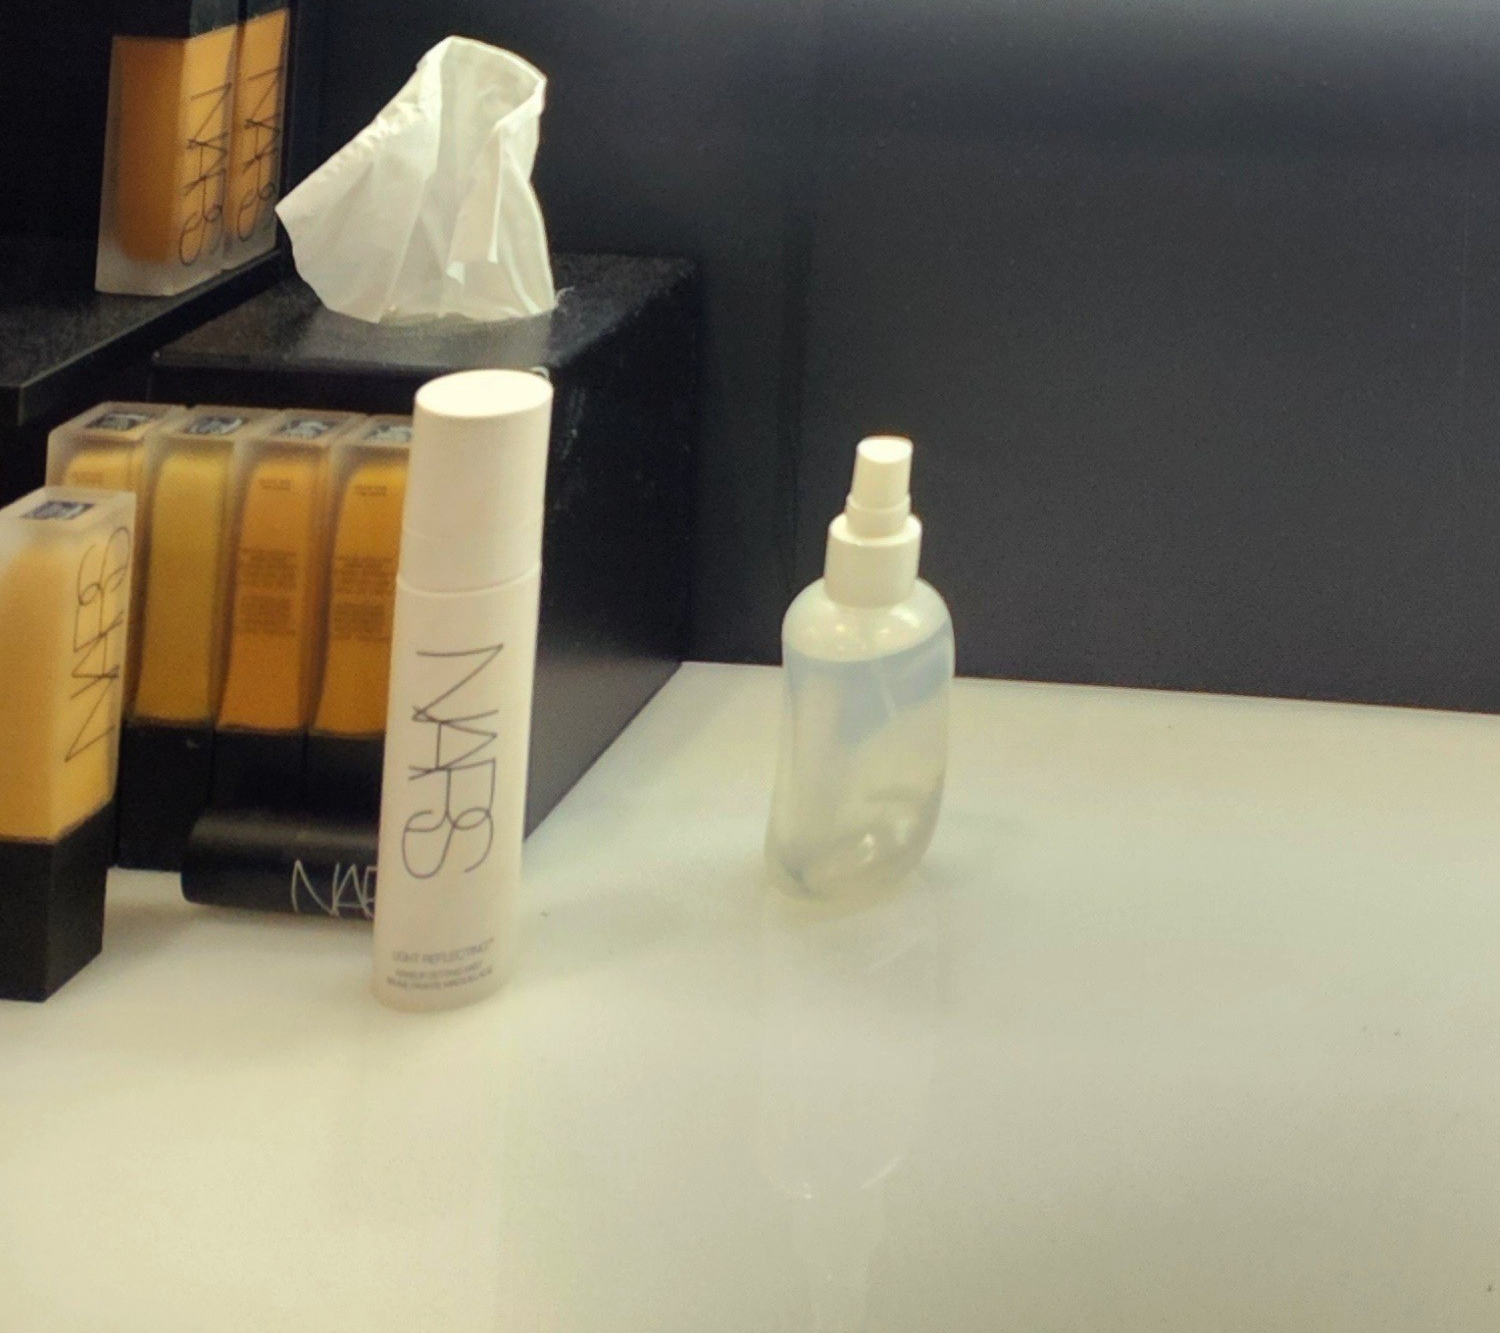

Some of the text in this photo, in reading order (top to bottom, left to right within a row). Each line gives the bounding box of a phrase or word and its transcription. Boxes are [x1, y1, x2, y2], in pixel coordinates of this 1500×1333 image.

[179, 83, 232, 267] NARS
[237, 65, 282, 243] NARS
[65, 525, 131, 764] NARS
[401, 643, 504, 880] NARS
[290, 859, 378, 919] NA
